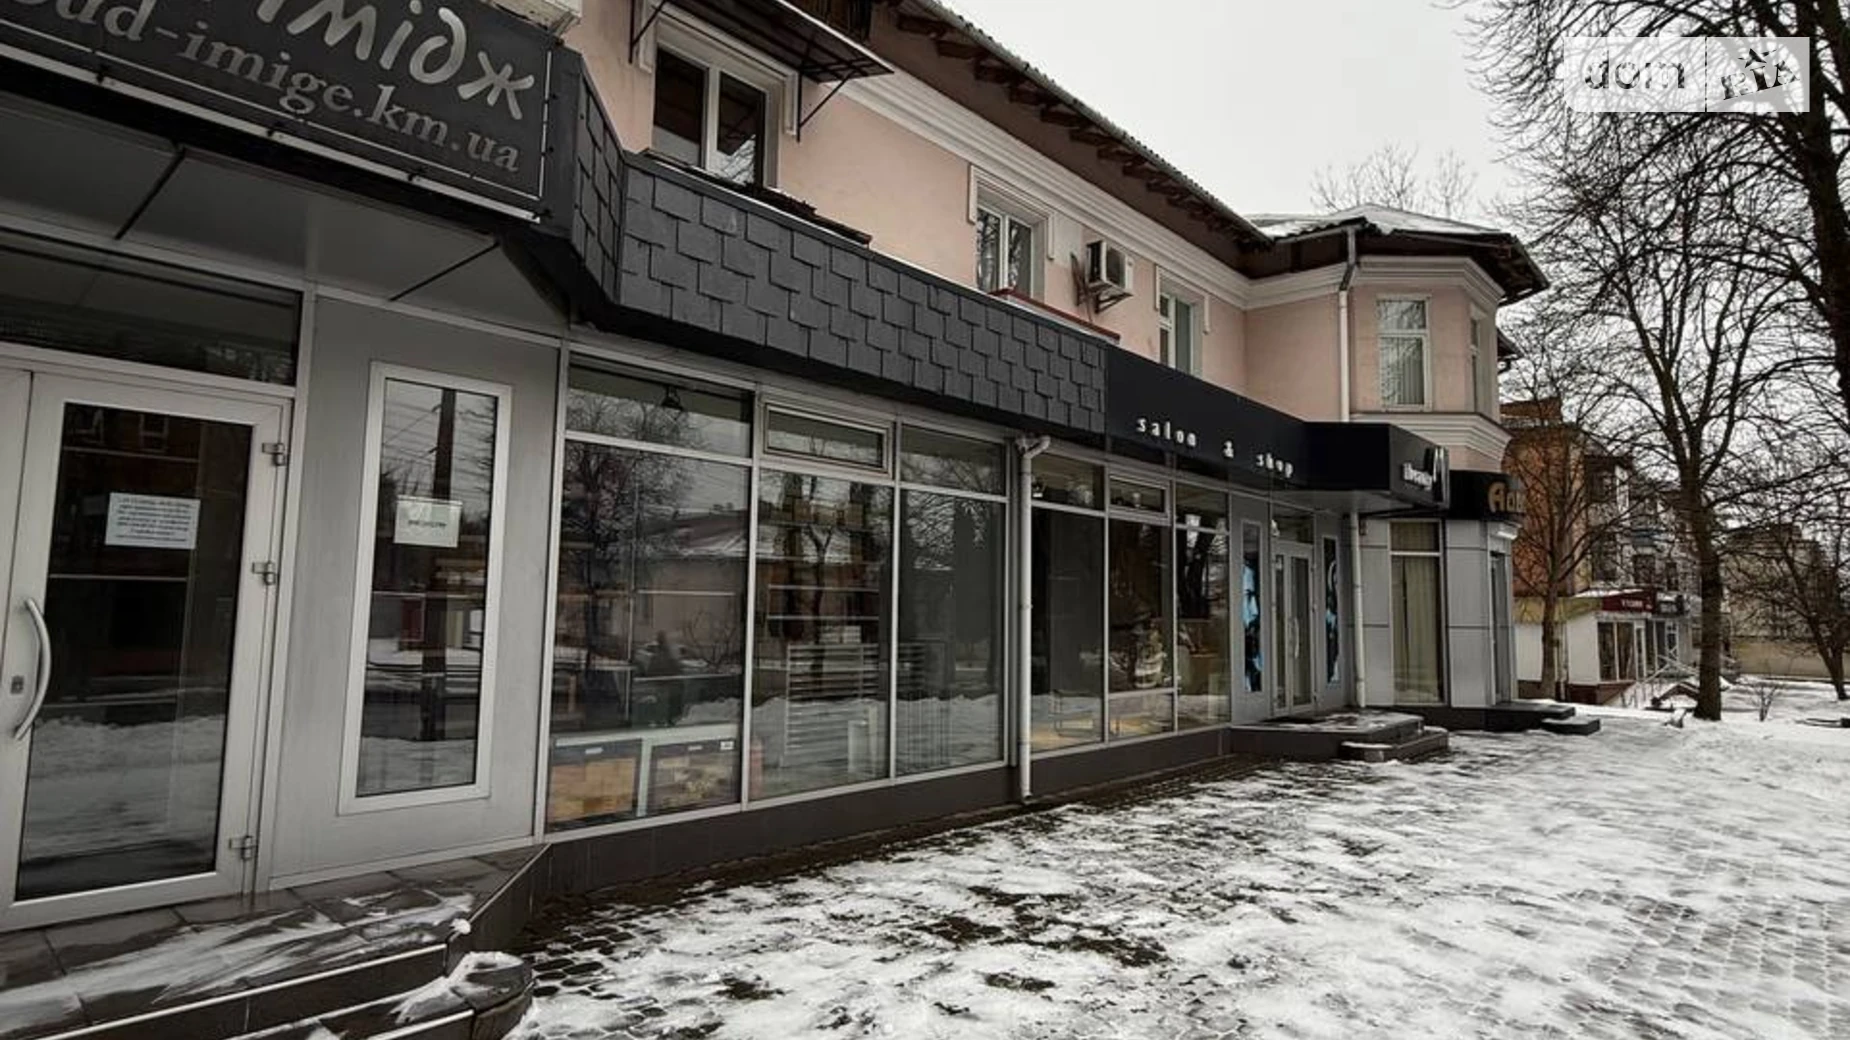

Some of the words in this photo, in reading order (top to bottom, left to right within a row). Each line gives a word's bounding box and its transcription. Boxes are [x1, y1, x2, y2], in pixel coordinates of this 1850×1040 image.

[14, 0, 520, 172] ud-imige.km.ua
[1136, 417, 1197, 448] salon
[1256, 452, 1295, 479] shop
